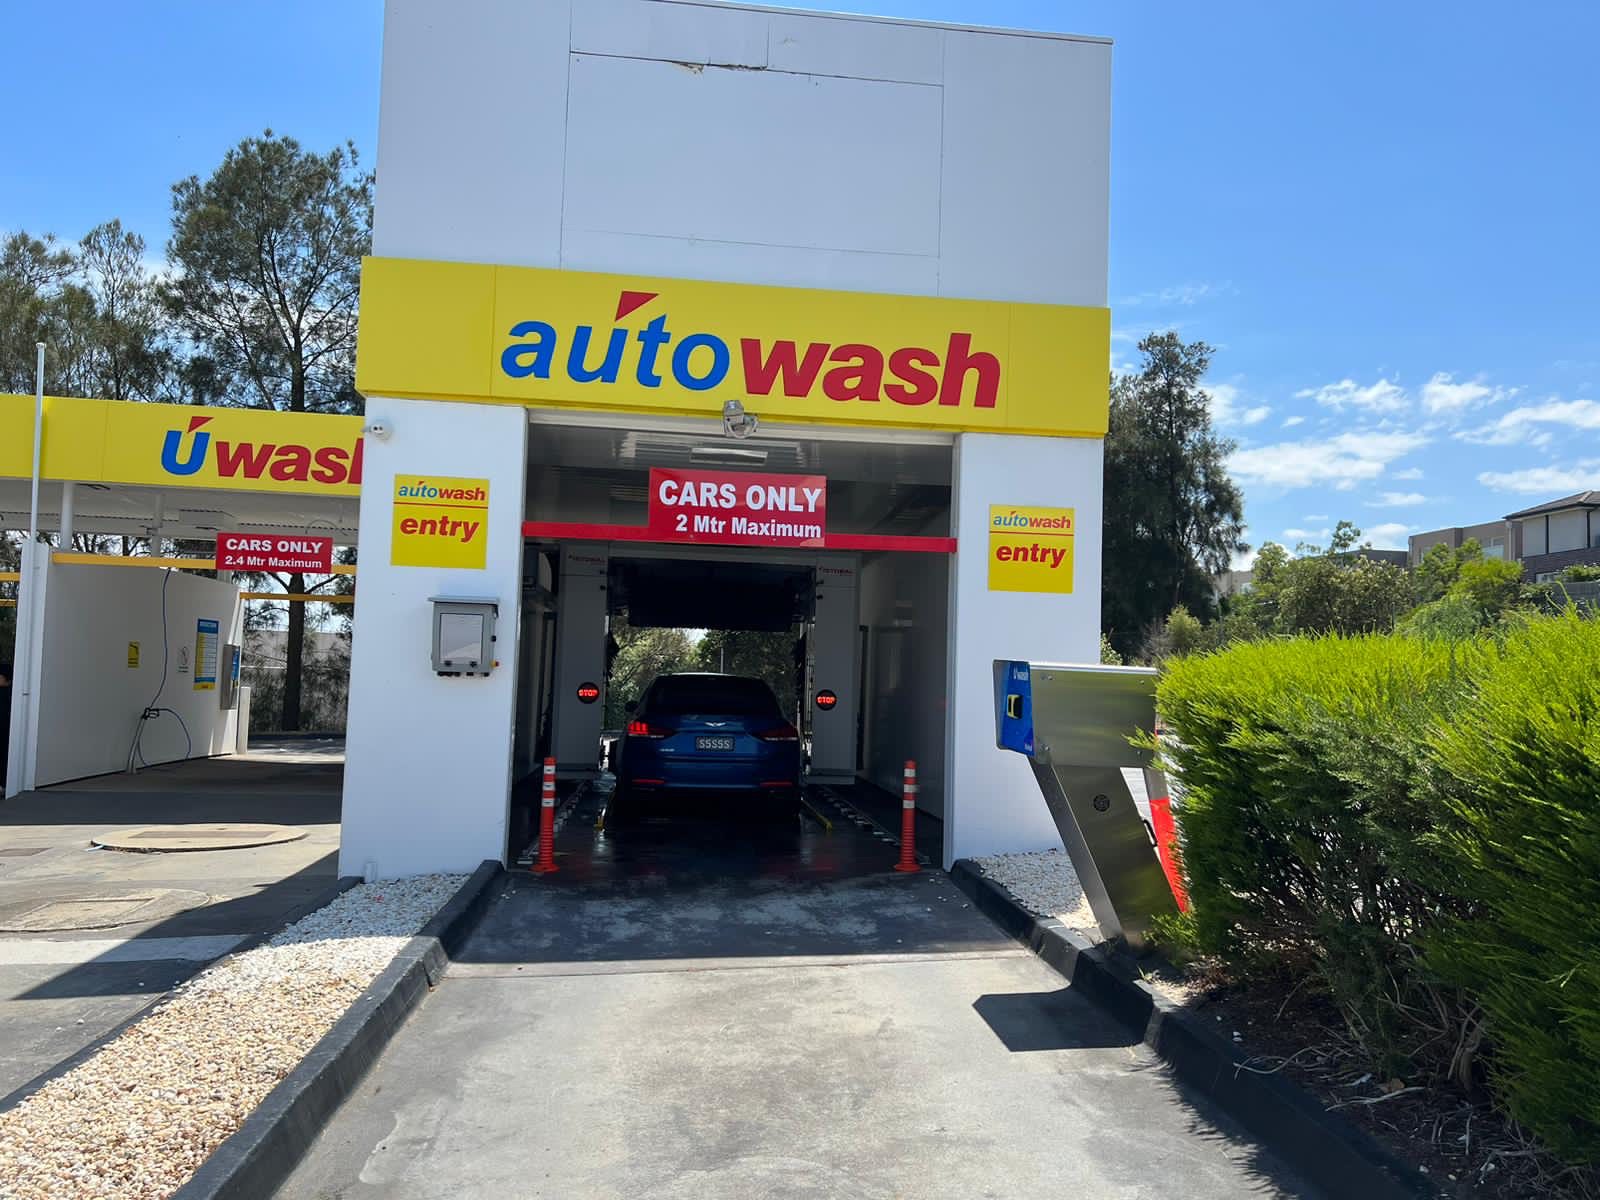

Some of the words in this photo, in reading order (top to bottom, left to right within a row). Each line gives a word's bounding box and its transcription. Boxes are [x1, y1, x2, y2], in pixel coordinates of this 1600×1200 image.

[659, 480, 737, 509] CARS
[745, 484, 822, 513] ONLY
[400, 515, 480, 543] entry
[675, 514, 688, 532] 2
[693, 515, 726, 534] Mtr
[731, 517, 821, 538] Maximum
[226, 538, 272, 552] CARS
[277, 541, 323, 554] ONLY
[996, 543, 1067, 569] entry
[225, 555, 244, 565] 2.4
[246, 556, 266, 567] Mtr
[268, 557, 322, 569] Maximum
[578, 688, 598, 697] STOP
[817, 695, 836, 704] STOP
